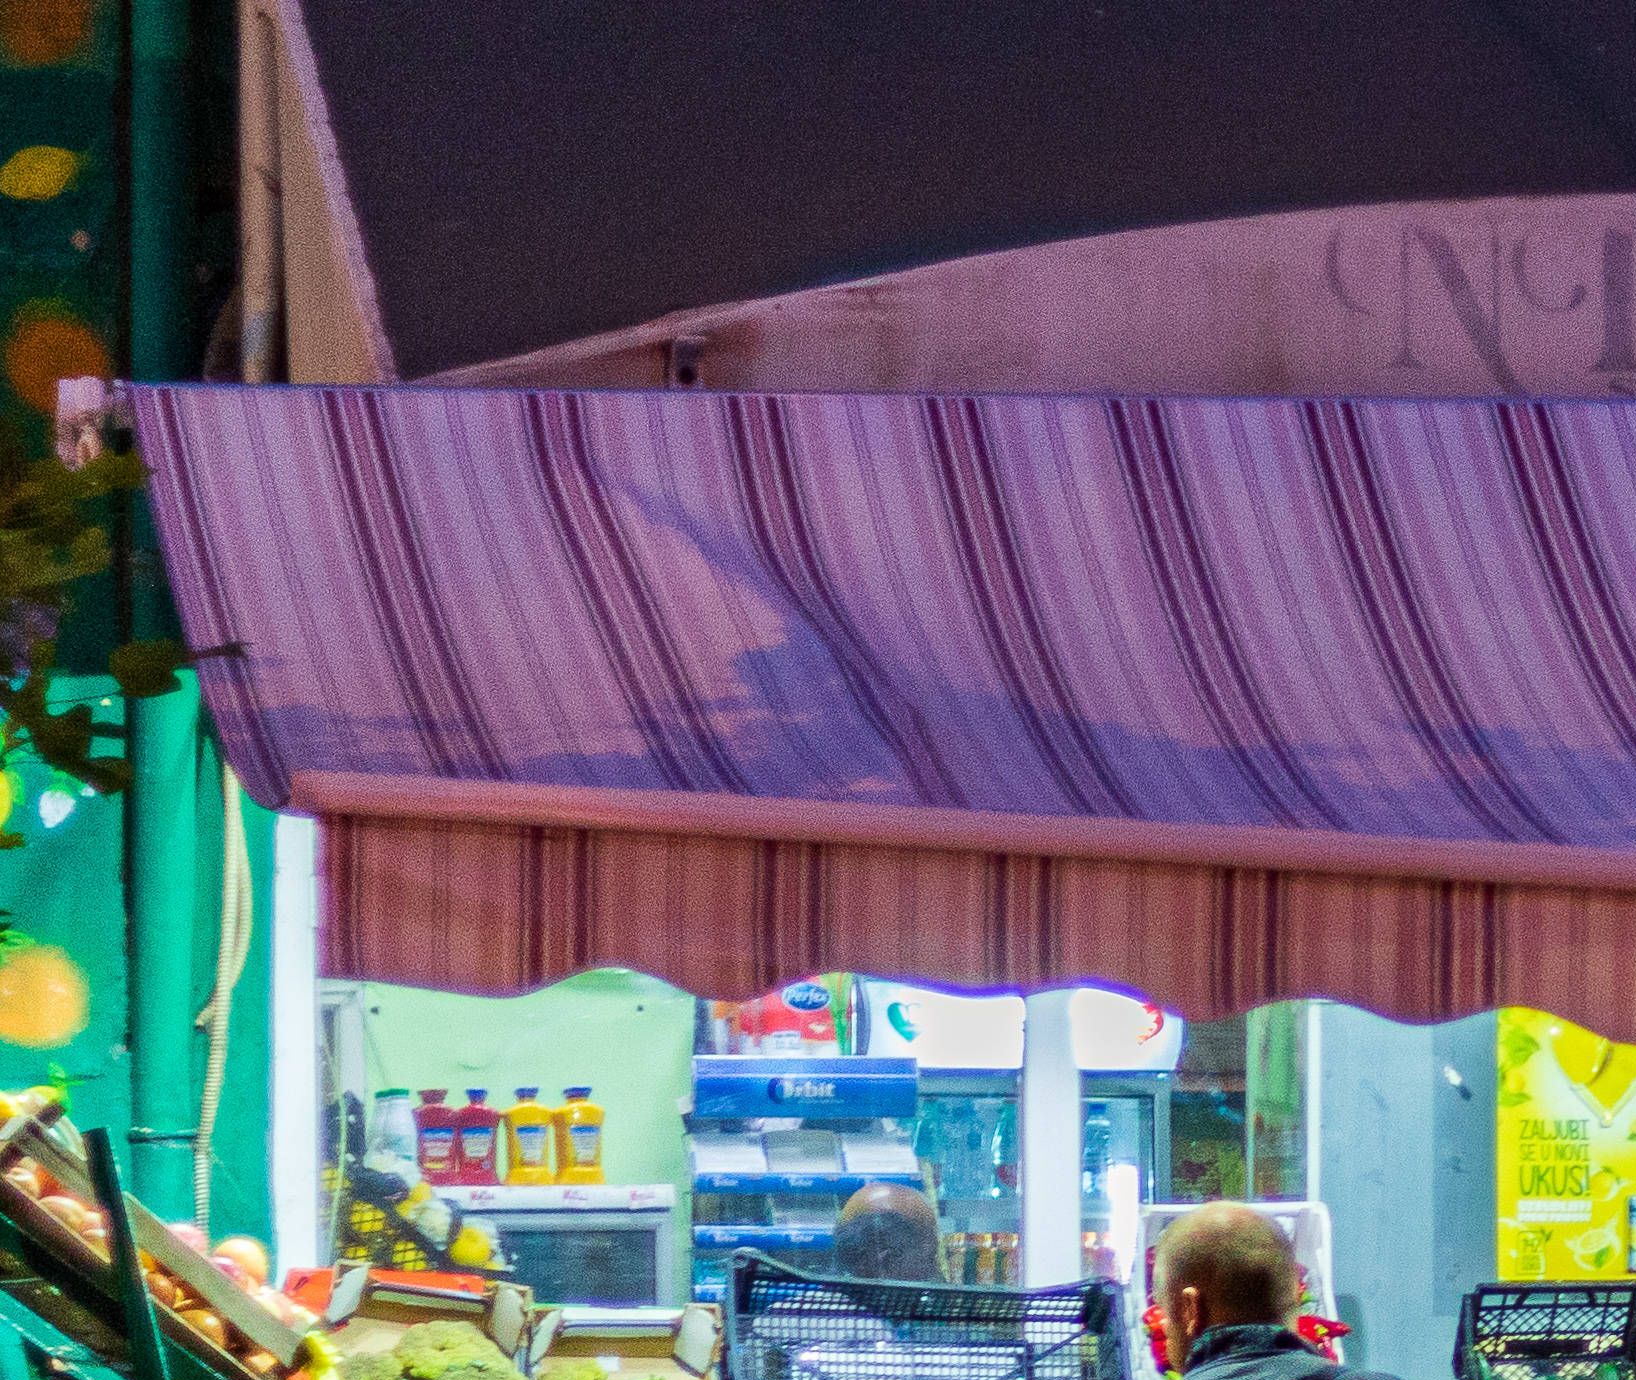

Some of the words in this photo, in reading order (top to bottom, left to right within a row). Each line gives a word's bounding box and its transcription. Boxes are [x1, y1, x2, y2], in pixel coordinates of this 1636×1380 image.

[1519, 1119, 1591, 1141] ZALJUBI
[1519, 1144, 1536, 1161] SE
[1540, 1144, 1551, 1161] U
[1554, 1144, 1591, 1161] NOVI
[1519, 1164, 1592, 1197] UKUS!
